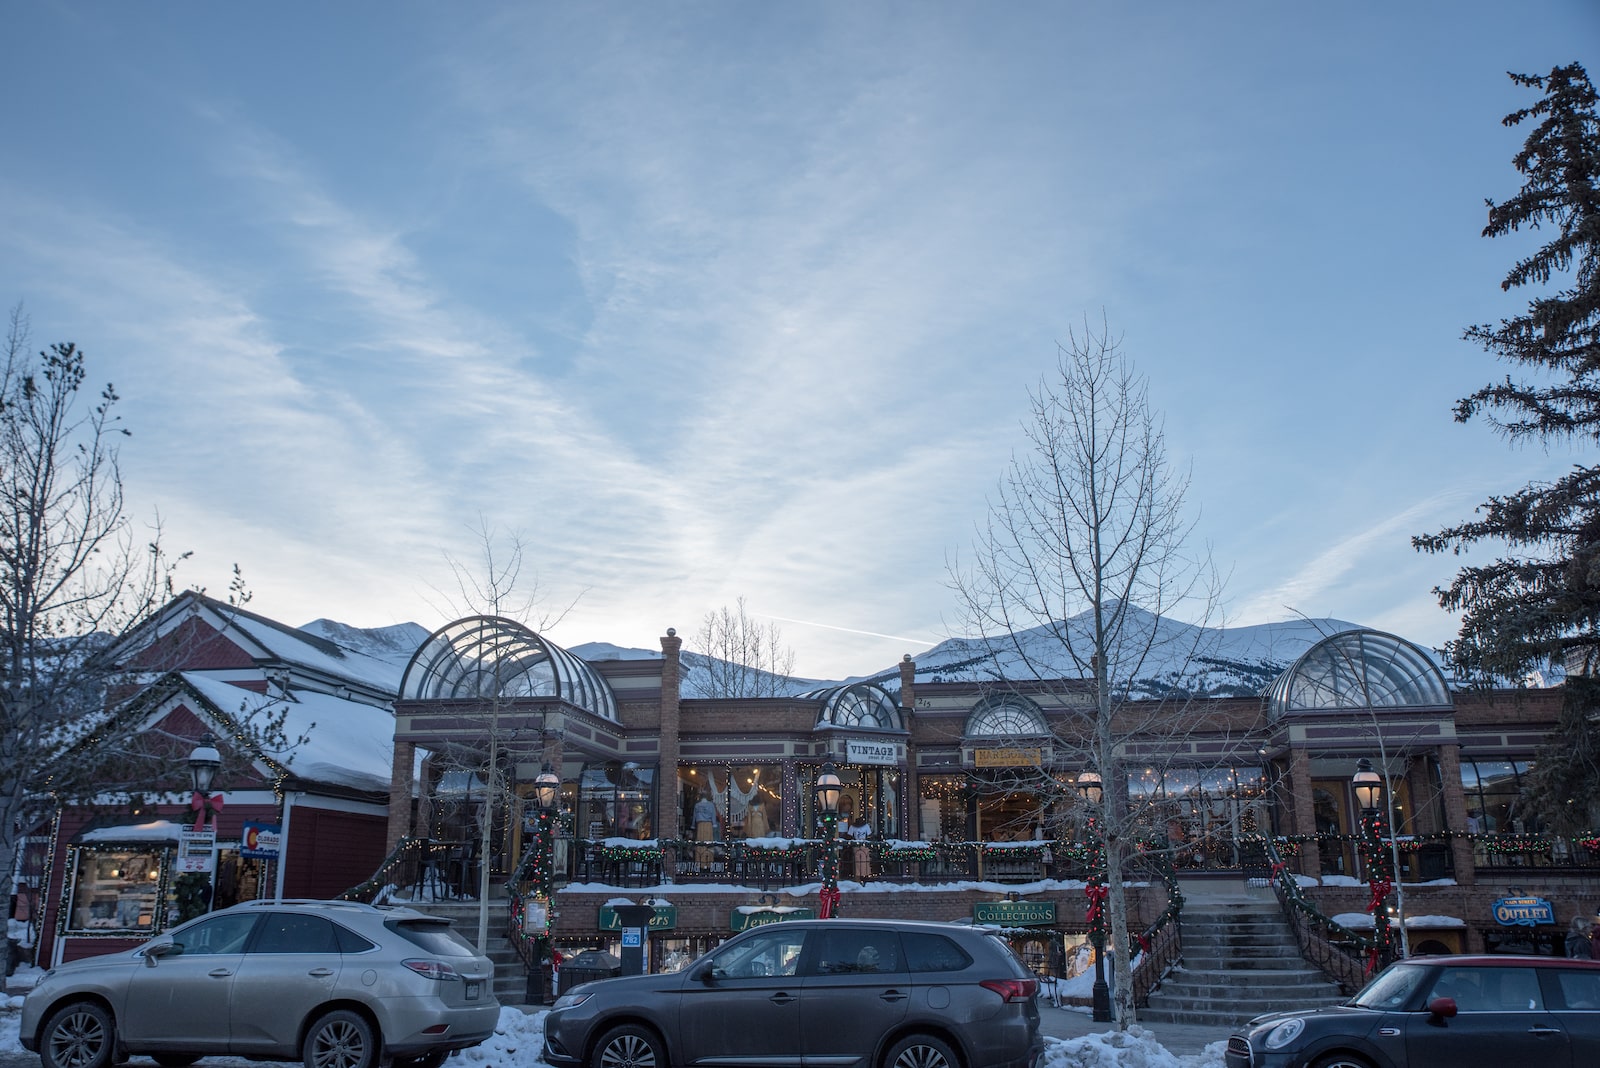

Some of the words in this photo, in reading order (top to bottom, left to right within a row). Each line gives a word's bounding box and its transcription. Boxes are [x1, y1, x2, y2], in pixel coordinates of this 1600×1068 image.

[918, 697, 931, 709] 215
[850, 745, 894, 756] VINTAGE
[977, 909, 1053, 921] COLLECTIONS
[1497, 906, 1548, 921] OUTLET
[625, 936, 638, 944] 782
